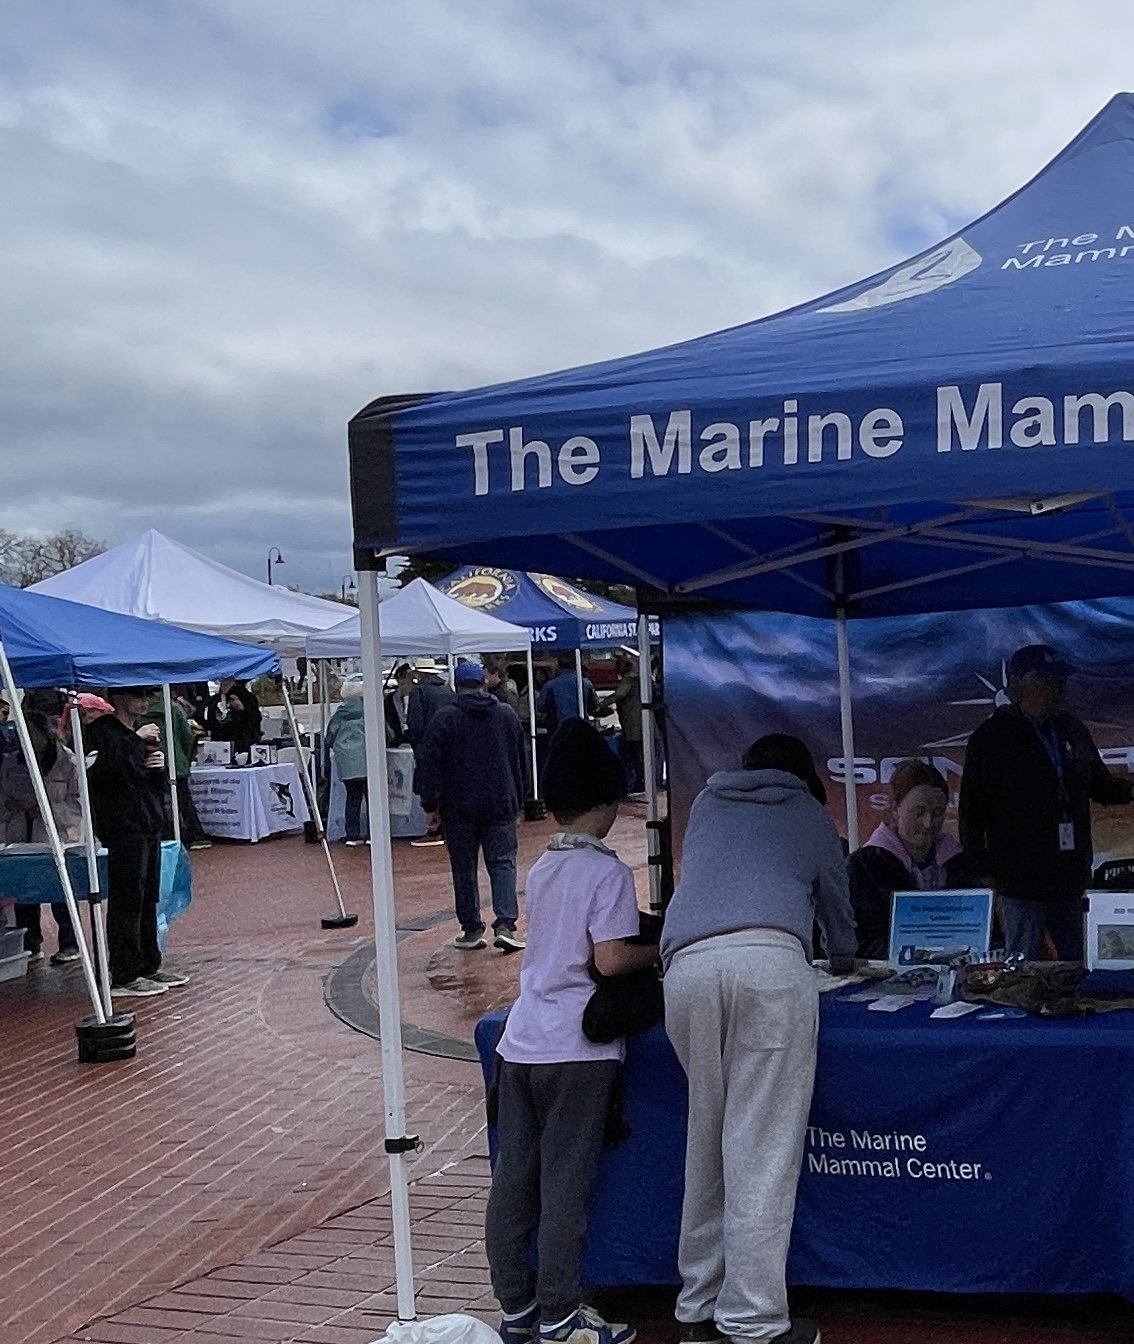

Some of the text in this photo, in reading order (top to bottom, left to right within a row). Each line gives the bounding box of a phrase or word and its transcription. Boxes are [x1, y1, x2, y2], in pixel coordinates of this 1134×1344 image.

[1016, 230, 1098, 255] The
[456, 425, 600, 496] The
[629, 399, 905, 480] Marine
[806, 1126, 927, 1152] The Marine
[808, 1153, 901, 1178] Mammal
